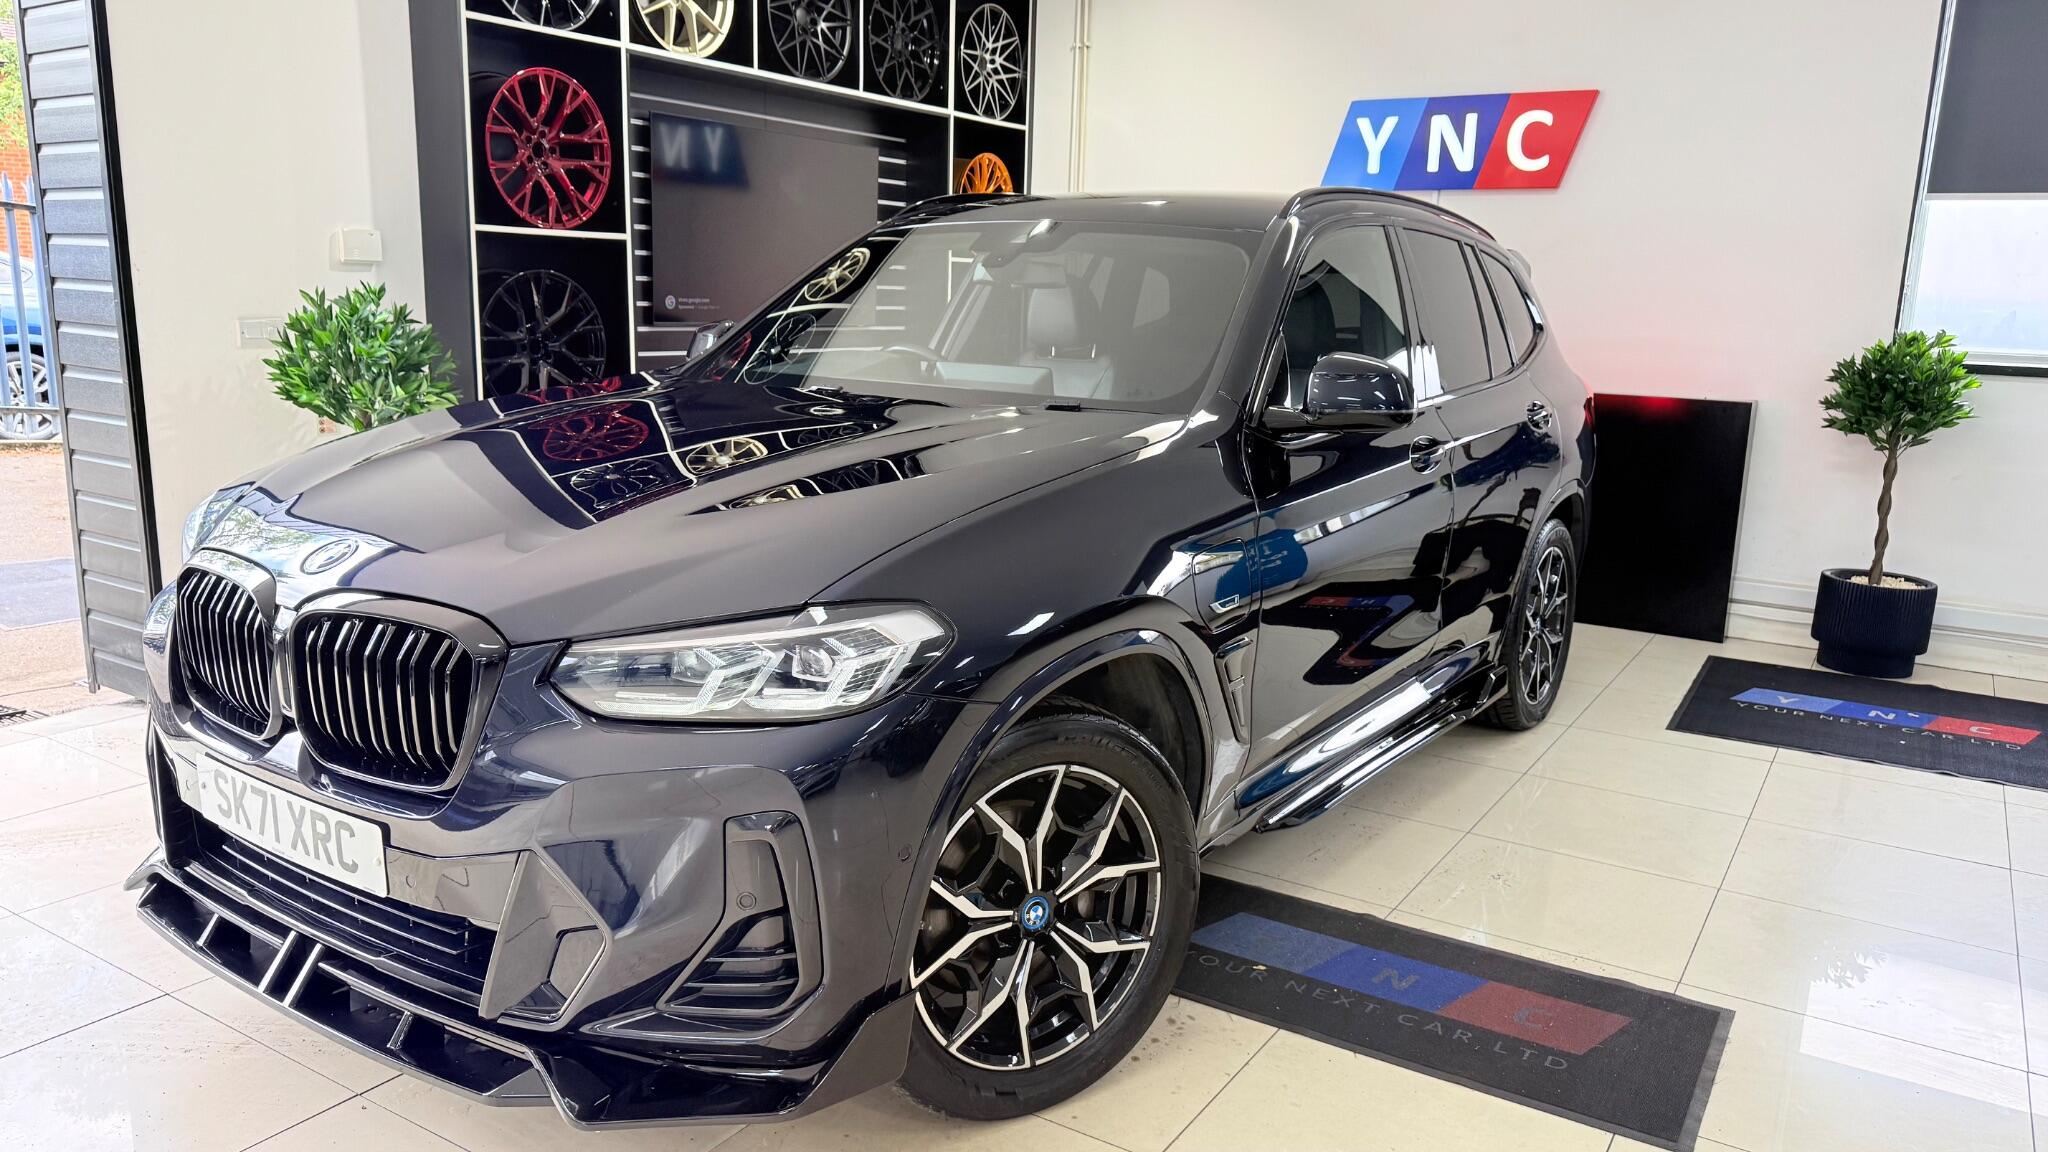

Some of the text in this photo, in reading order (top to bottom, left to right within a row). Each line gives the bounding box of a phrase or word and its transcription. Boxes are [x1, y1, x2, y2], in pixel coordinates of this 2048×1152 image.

[1356, 109, 1554, 174] YNC
[1736, 702, 2022, 750] YOUR NEXT CAR LTD
[213, 768, 359, 874] SK71 XRC
[1284, 979, 1381, 1014] NEXT
[1397, 1013, 1473, 1043] CAR
[1493, 1041, 1569, 1070] LTD
